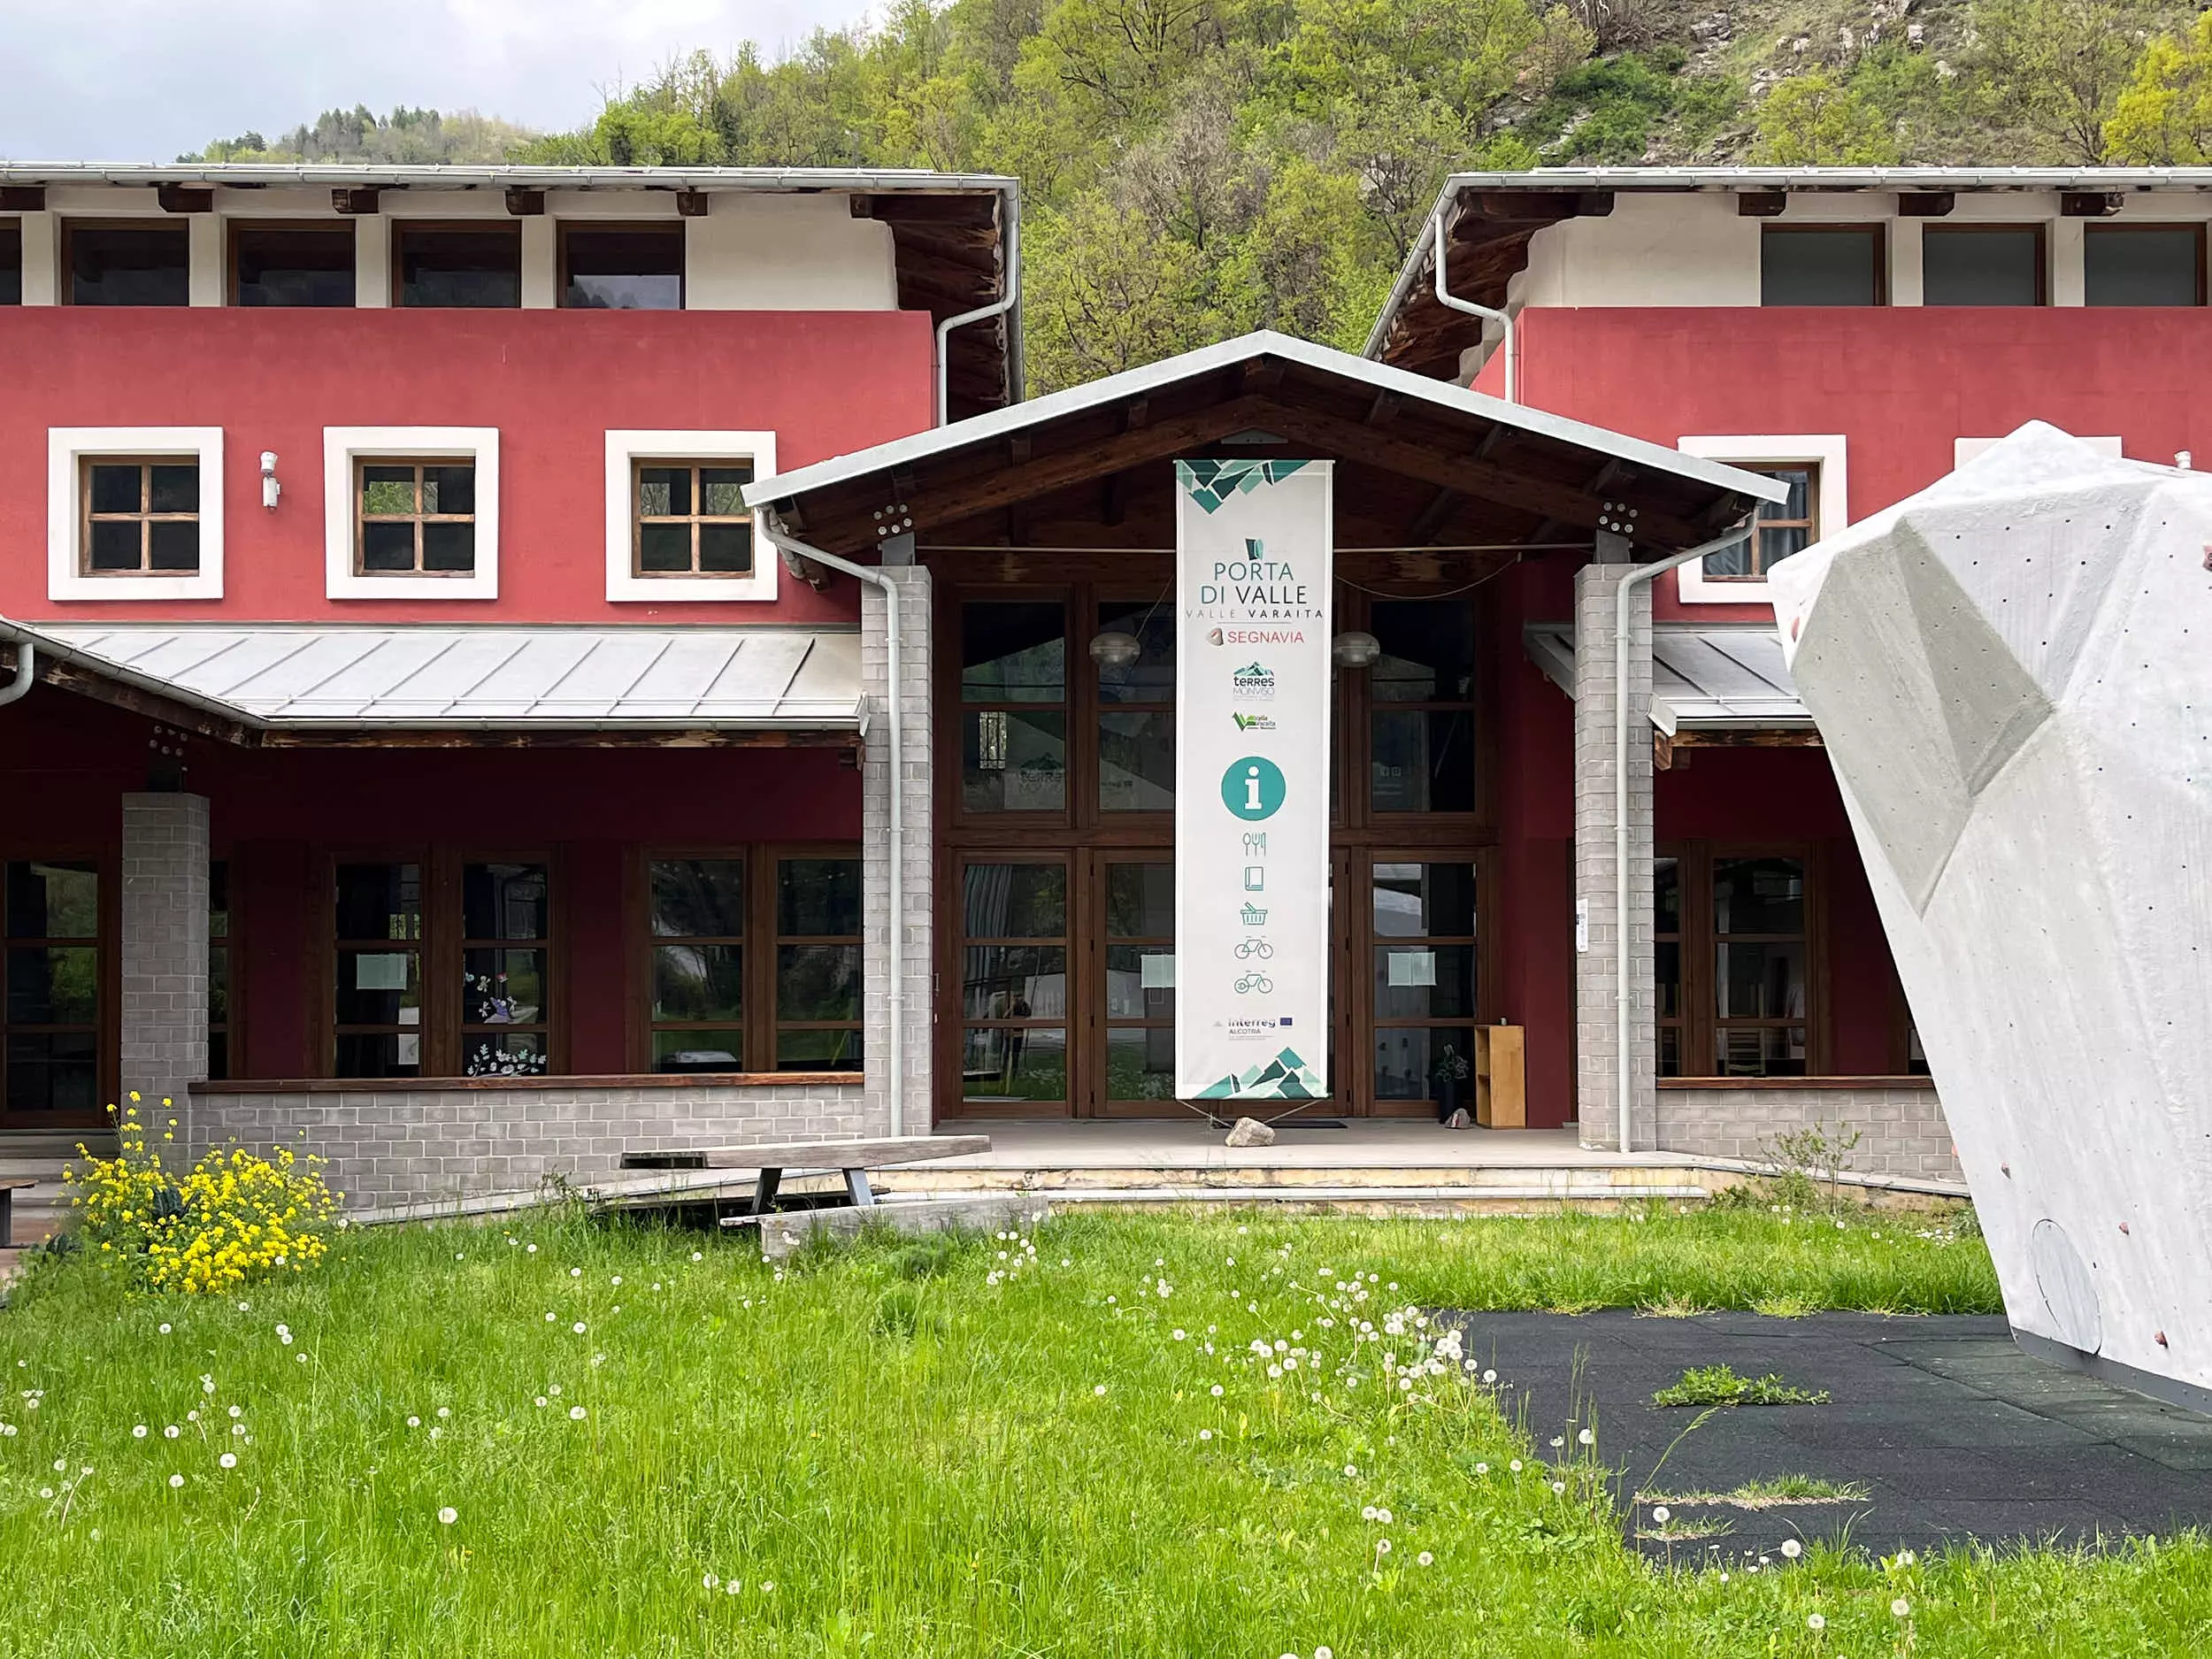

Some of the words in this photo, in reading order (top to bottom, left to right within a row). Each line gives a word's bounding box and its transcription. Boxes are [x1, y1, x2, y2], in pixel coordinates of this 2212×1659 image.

[1214, 562, 1294, 581] PORTA
[1201, 585, 1225, 604] DI
[1235, 585, 1307, 604] VALLE
[1186, 609, 1236, 618] VALLE
[1248, 609, 1323, 618] VARAITA
[1227, 631, 1304, 644] SEGNAVIA
